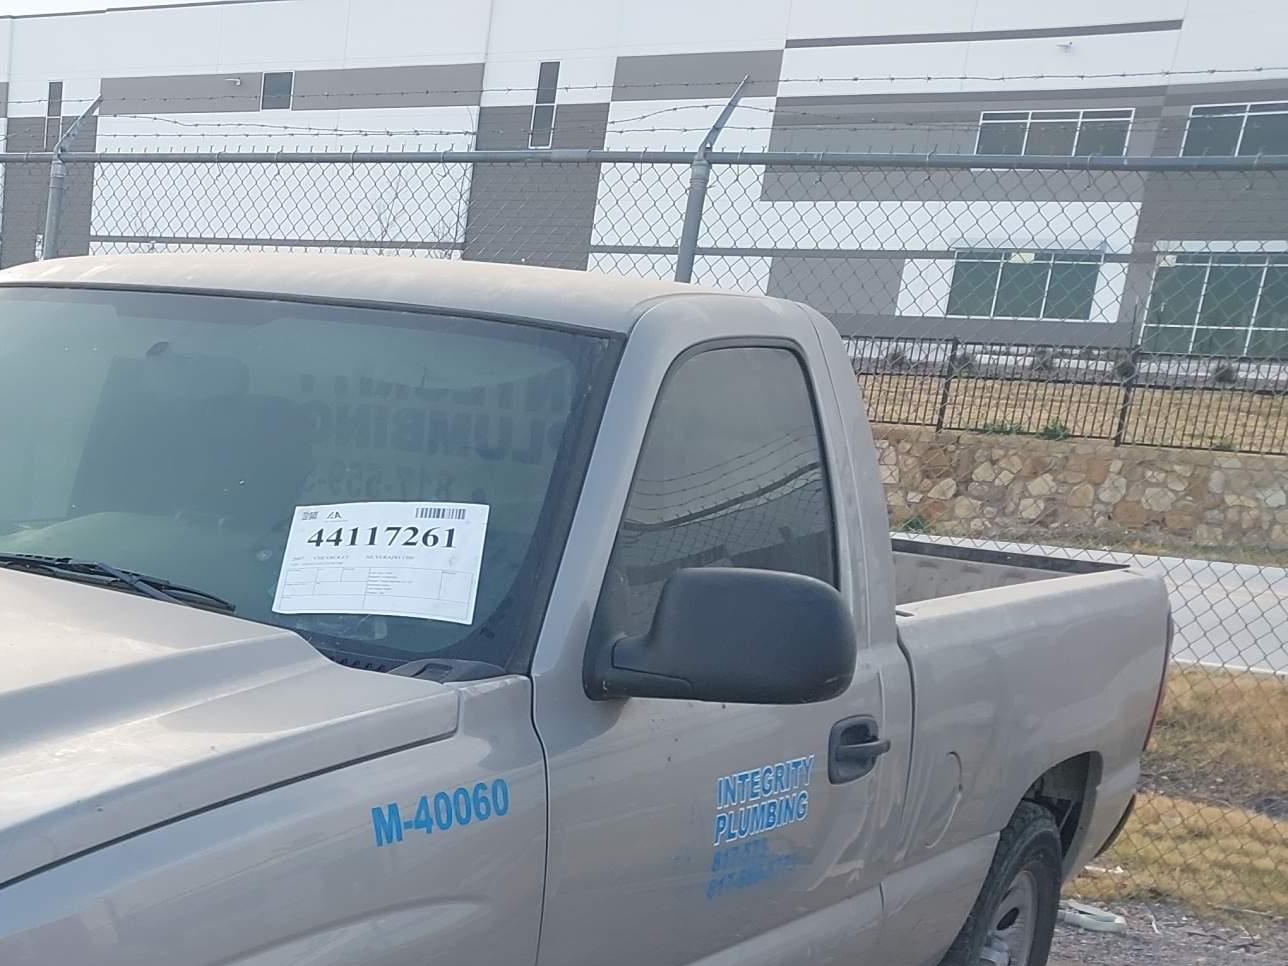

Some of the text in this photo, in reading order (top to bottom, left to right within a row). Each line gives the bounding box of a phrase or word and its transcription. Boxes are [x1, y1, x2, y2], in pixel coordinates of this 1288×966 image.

[307, 526, 457, 549] 44117261
[716, 754, 815, 810] INTEGRITY
[371, 778, 509, 848] M-40060
[714, 790, 810, 847] PLUMBING
